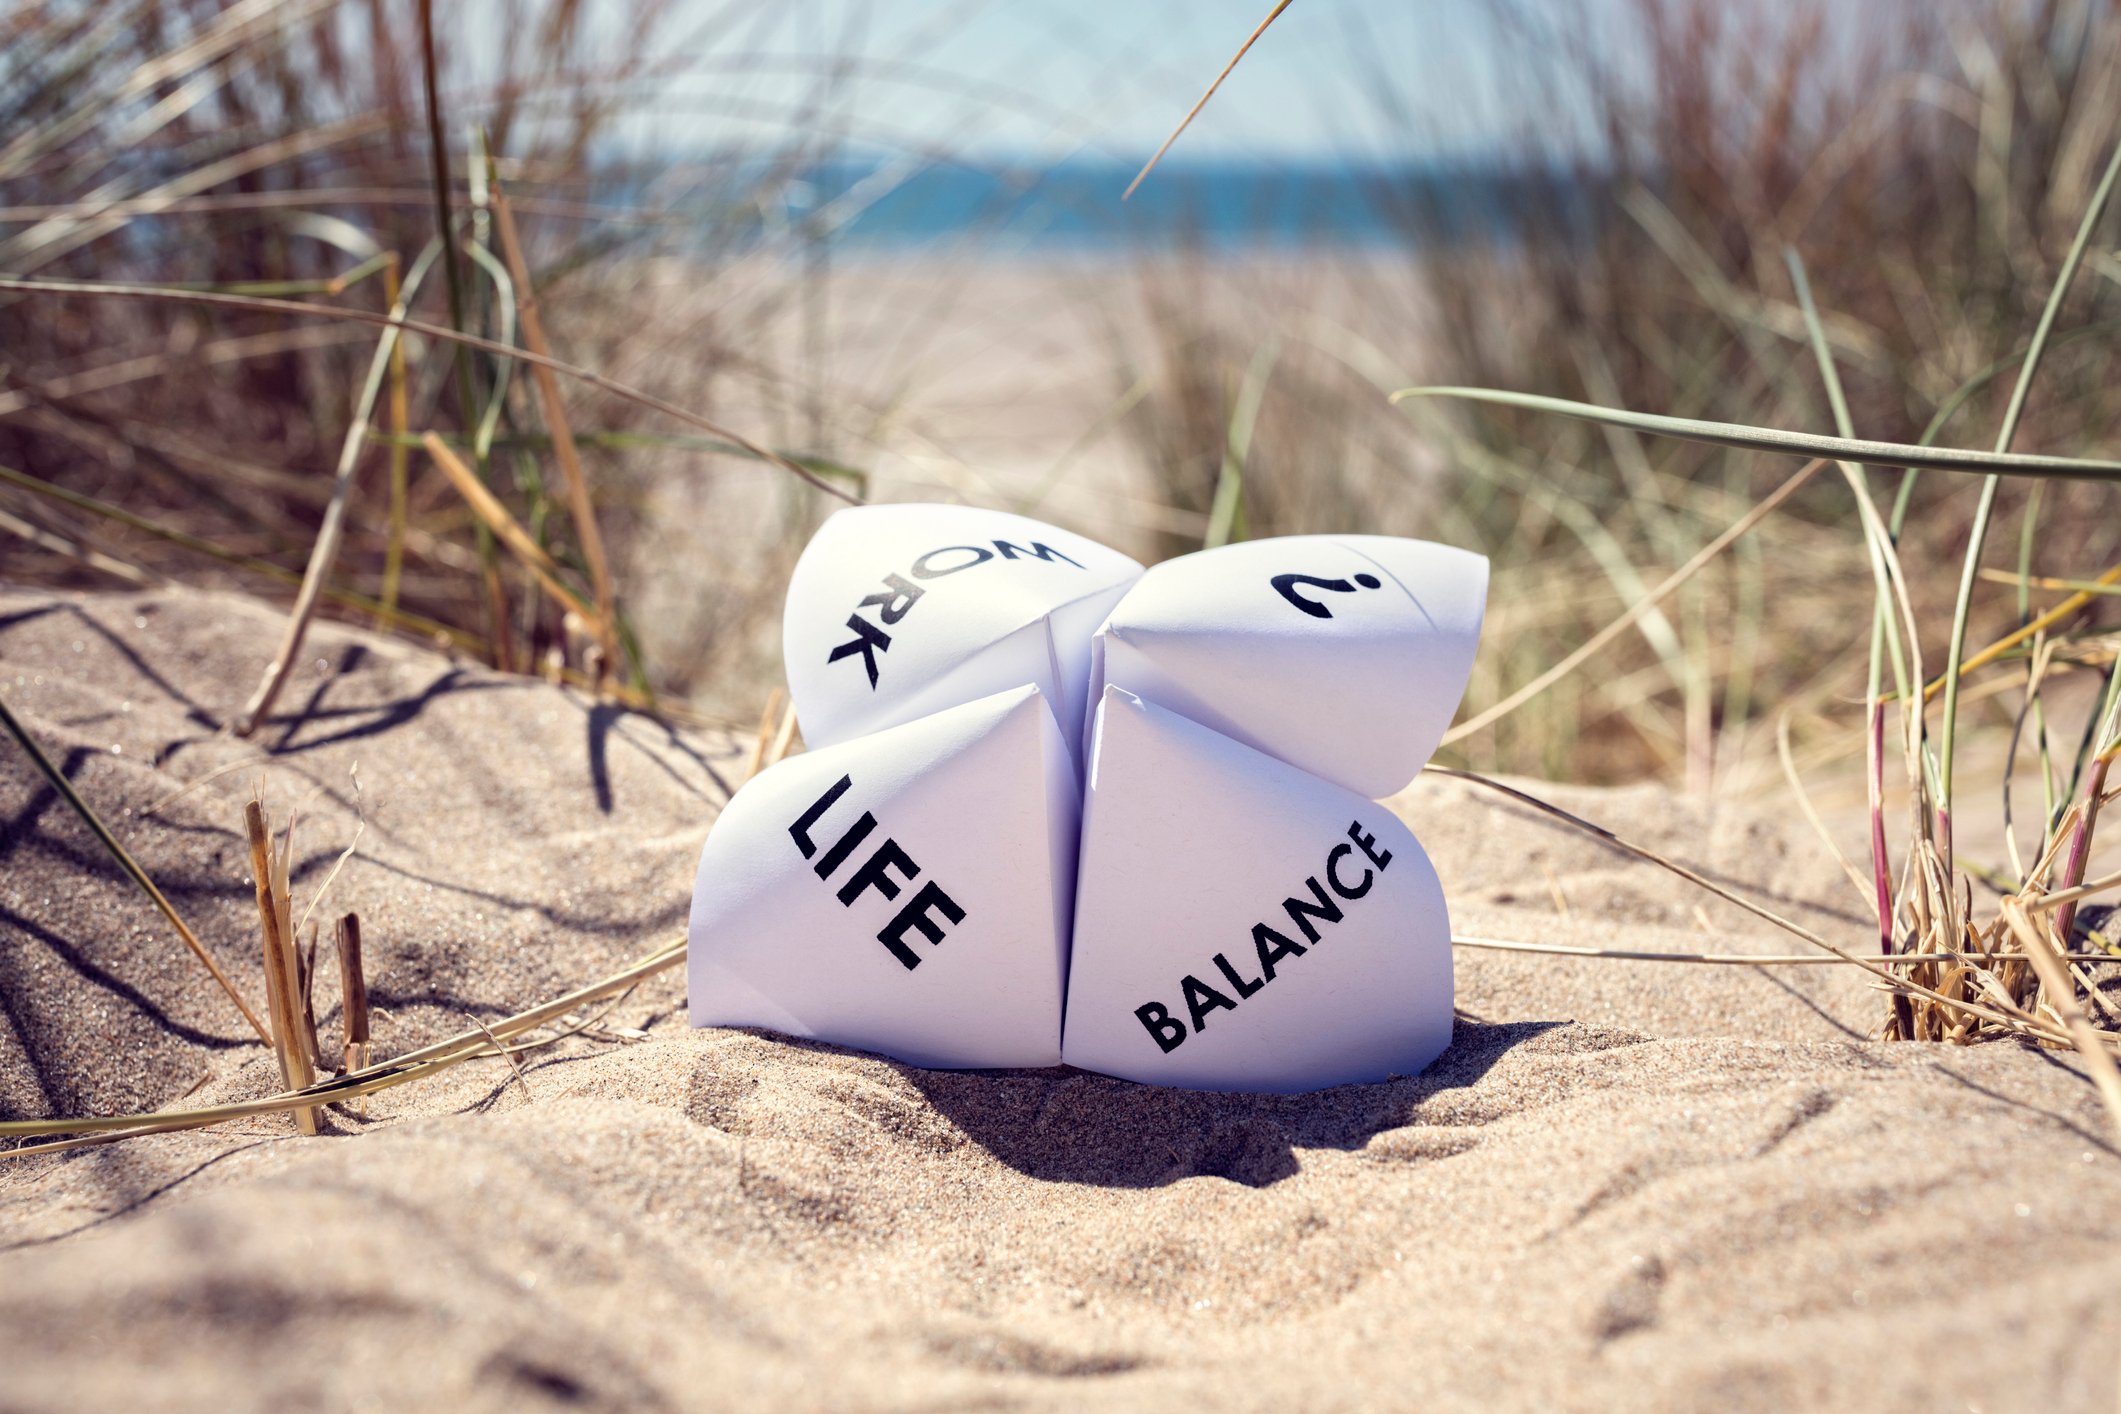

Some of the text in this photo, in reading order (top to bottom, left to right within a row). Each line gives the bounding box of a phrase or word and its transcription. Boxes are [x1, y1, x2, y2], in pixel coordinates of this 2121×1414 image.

[827, 540, 1088, 692] WORK
[1271, 573, 1381, 620] ?
[787, 773, 968, 972] LIFE
[1133, 819, 1393, 1055] BALANCE
